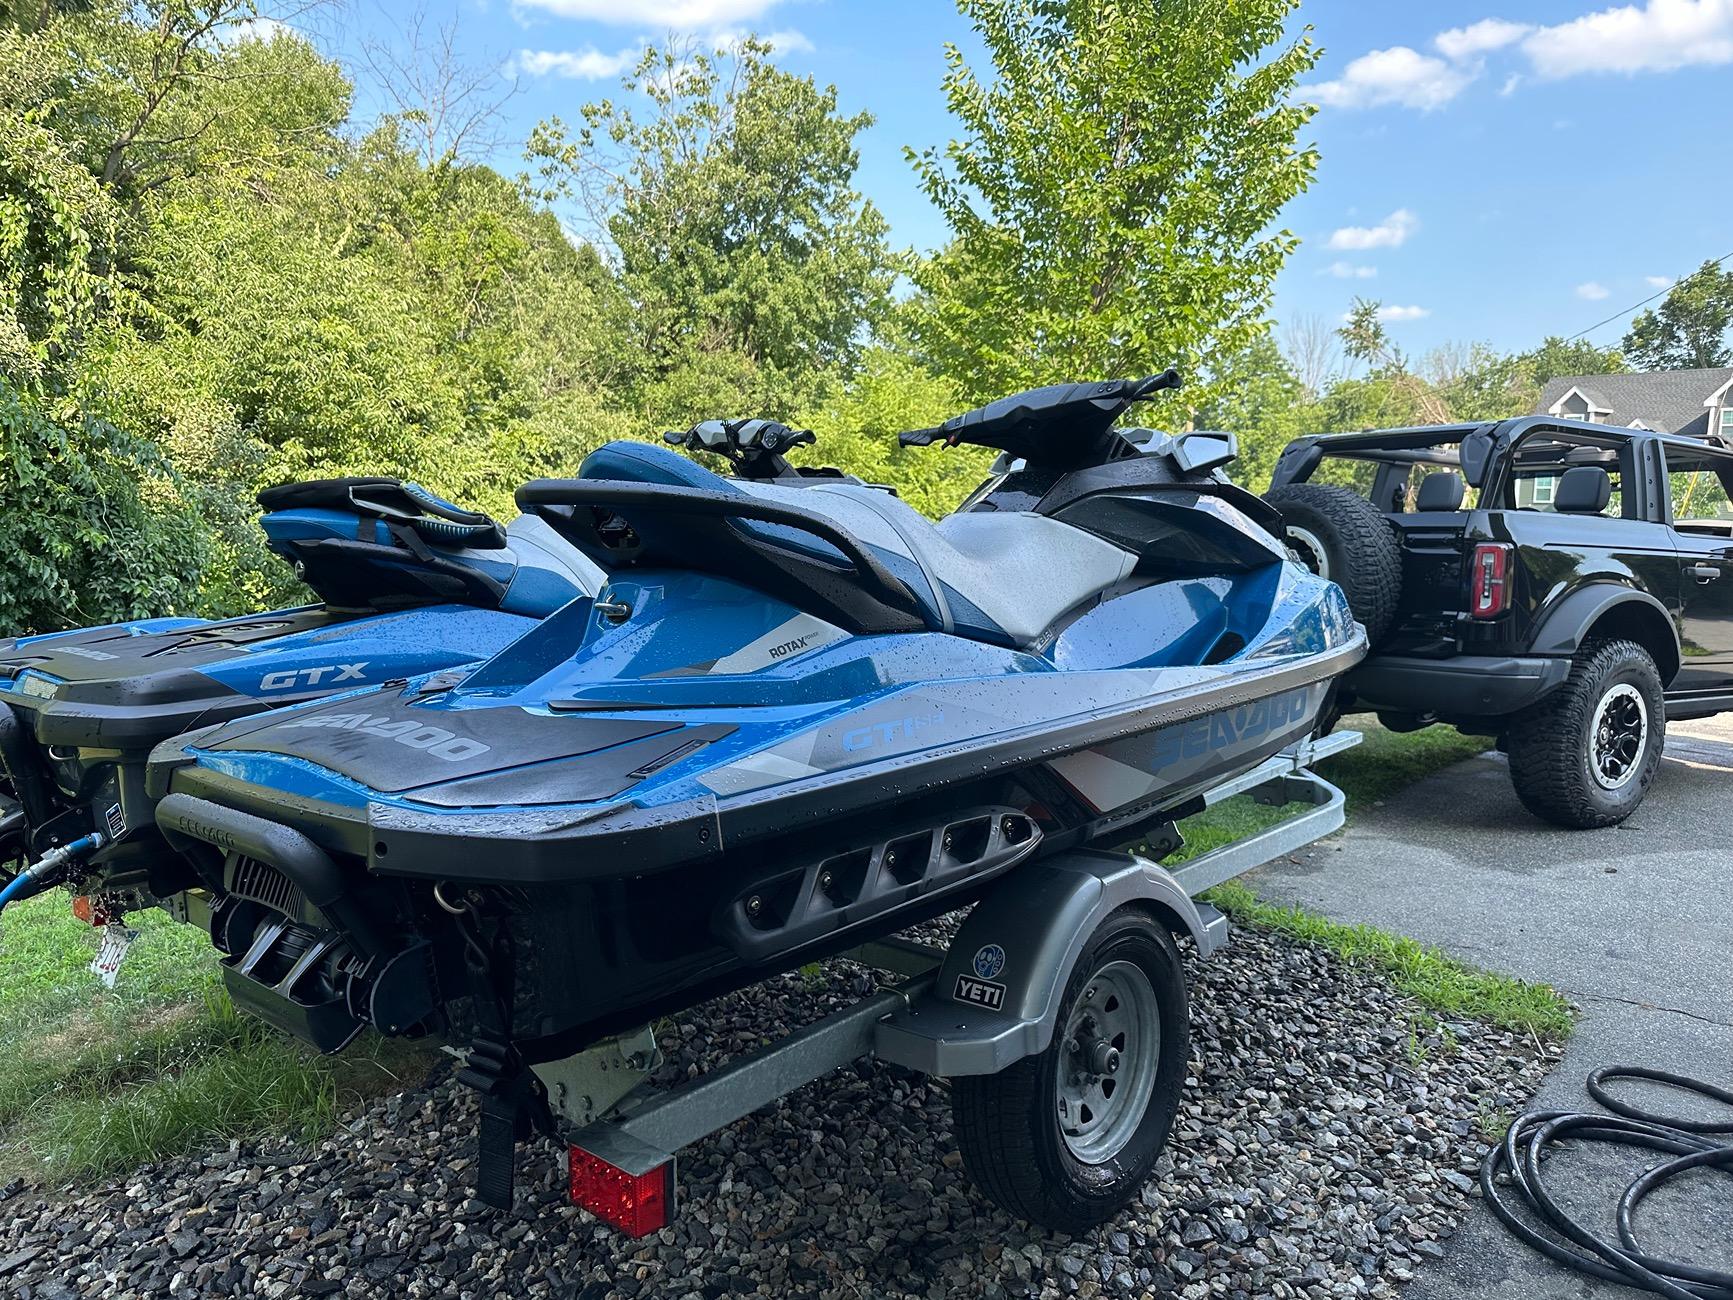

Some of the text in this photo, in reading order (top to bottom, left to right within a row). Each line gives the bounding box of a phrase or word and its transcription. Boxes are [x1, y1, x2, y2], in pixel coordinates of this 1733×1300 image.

[768, 636, 808, 659] ROTAX
[259, 661, 370, 691] GTX
[842, 716, 913, 752] GTI
[960, 980, 1001, 1005] YETI
